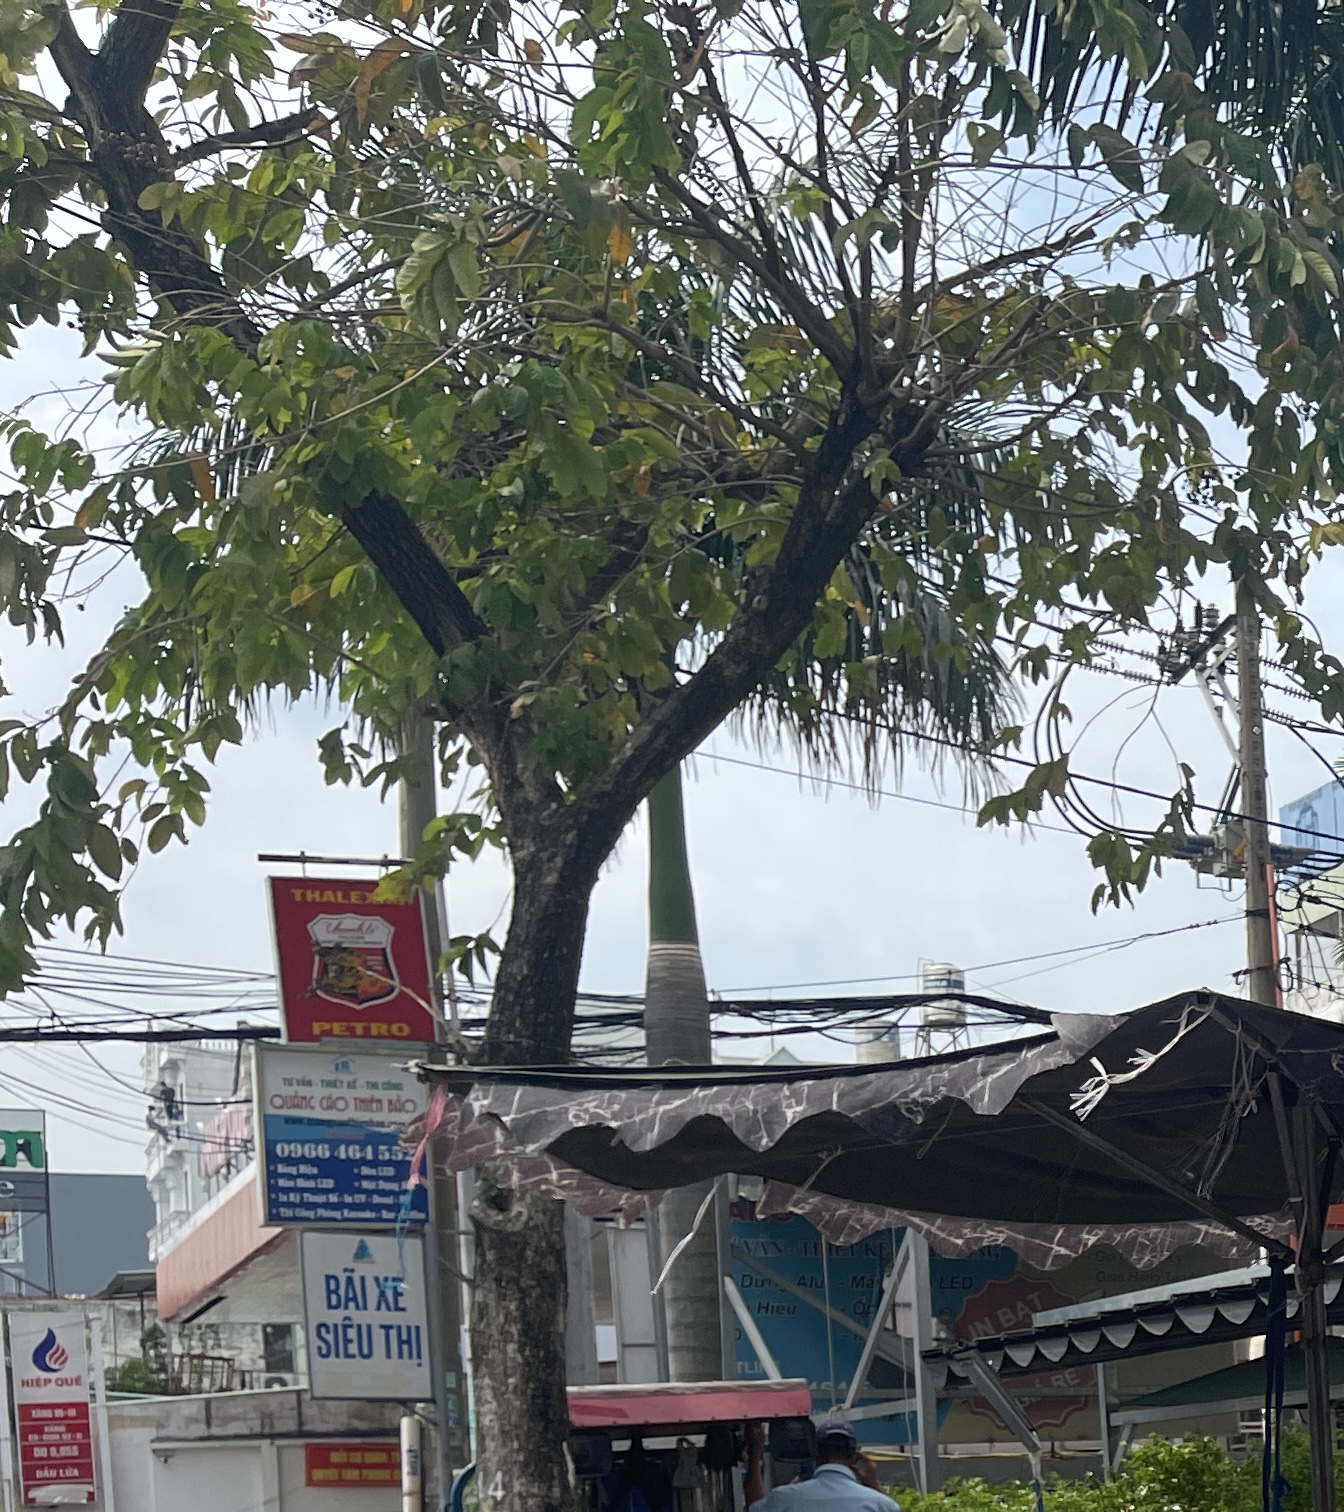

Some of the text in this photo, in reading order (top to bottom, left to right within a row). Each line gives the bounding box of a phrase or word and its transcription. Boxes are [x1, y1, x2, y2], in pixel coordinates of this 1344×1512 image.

[312, 1021, 411, 1037] PETRO
[275, 1142, 331, 1160] 0966
[334, 1144, 374, 1161] 464
[324, 1267, 408, 1313] BÃI XE
[939, 1275, 974, 1290] LED
[315, 1315, 423, 1368] SIÊU THỊ
